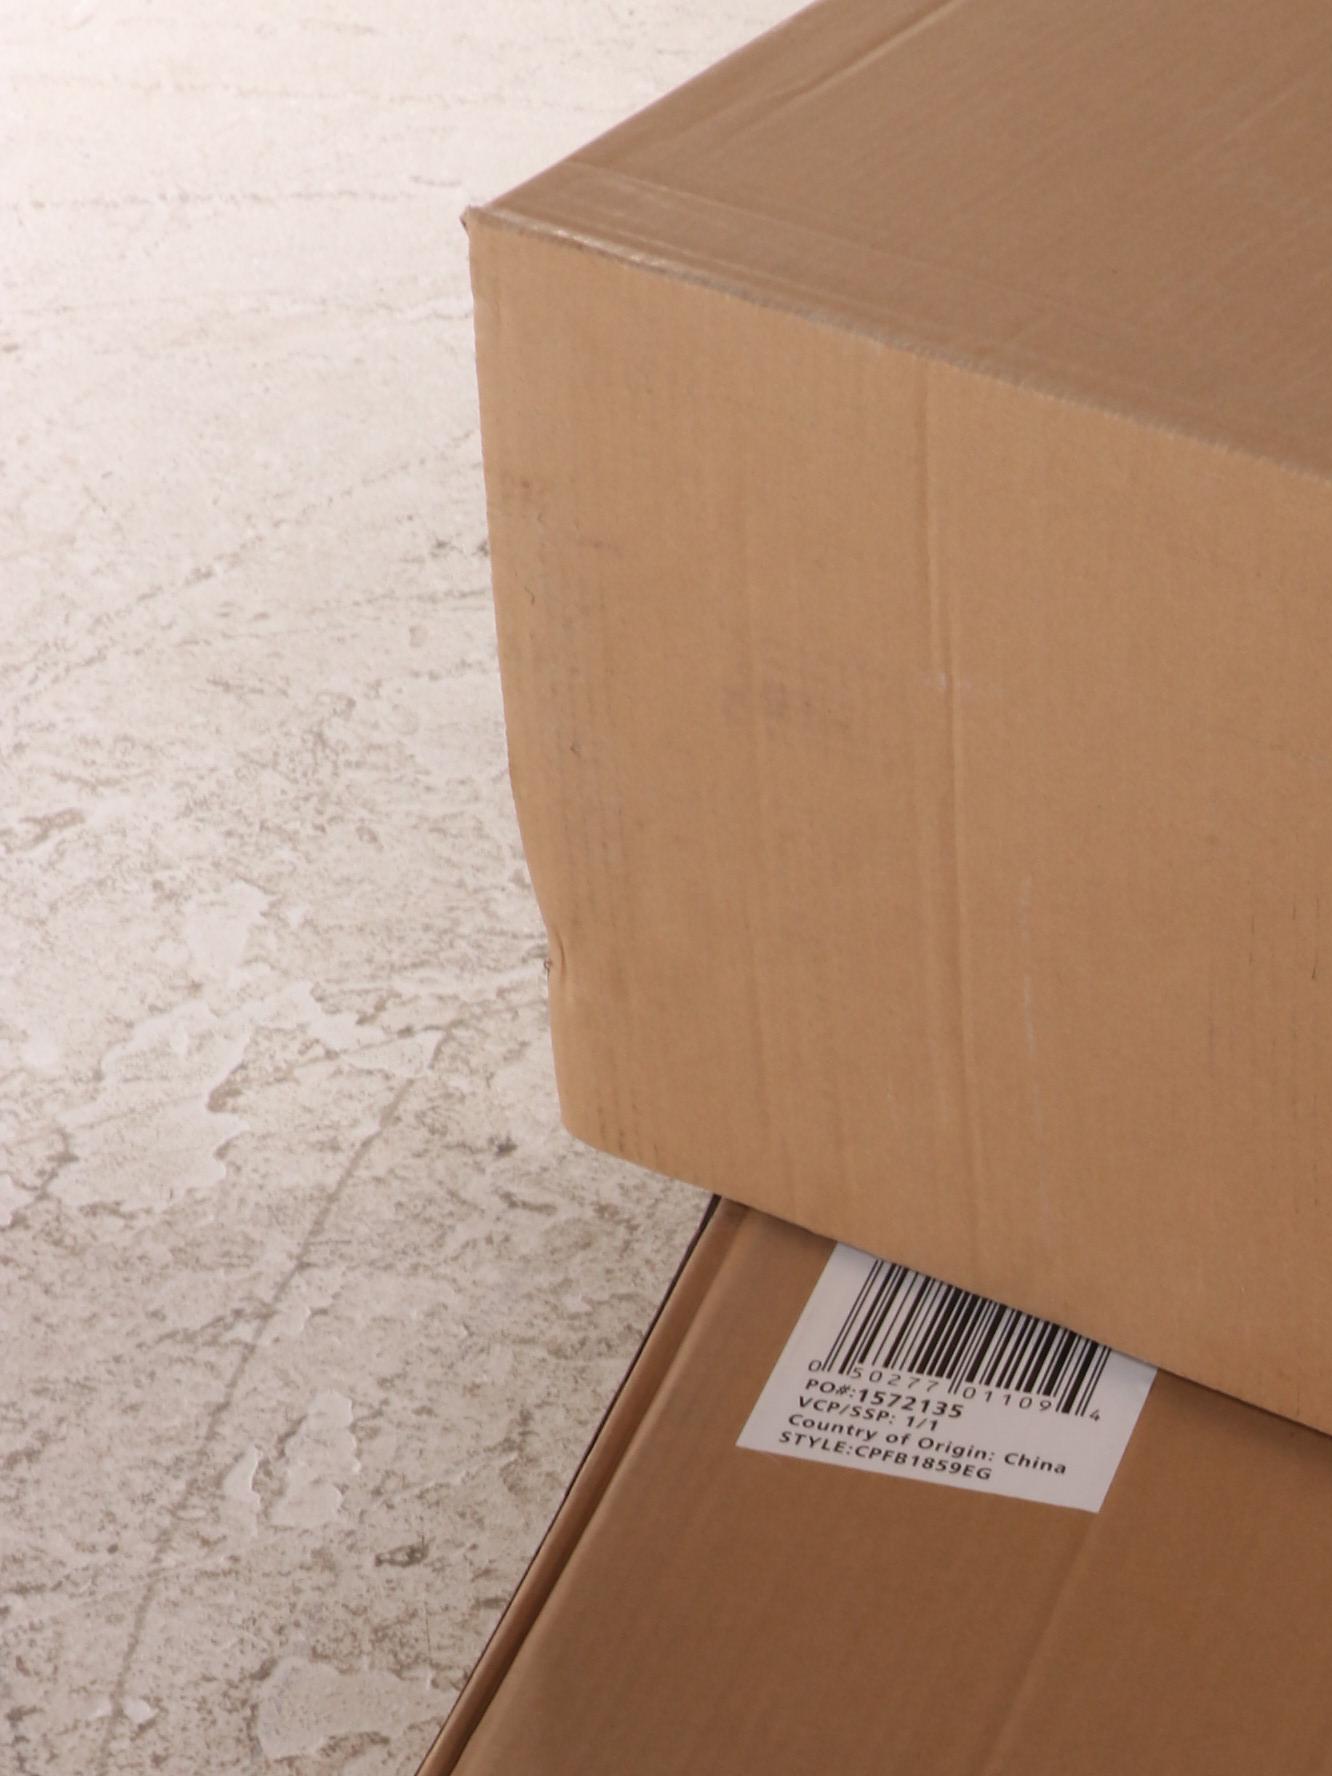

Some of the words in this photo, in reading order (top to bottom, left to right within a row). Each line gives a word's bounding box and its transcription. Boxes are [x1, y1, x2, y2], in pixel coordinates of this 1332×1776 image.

[798, 1396, 896, 1424] VCP/SSP:
[906, 1416, 938, 1431] 1/1
[806, 1378, 964, 1418] PO#:1572135
[808, 1360, 821, 1372] 0
[850, 1368, 939, 1393] 50277
[962, 1386, 1052, 1411] 01109
[1089, 1409, 1100, 1422] 4
[779, 1431, 992, 1480] STYLE:CPFB1859EG
[789, 1414, 878, 1441] Country
[886, 1431, 910, 1445] of
[918, 1437, 995, 1460] Origin:
[1004, 1453, 1067, 1474] China
